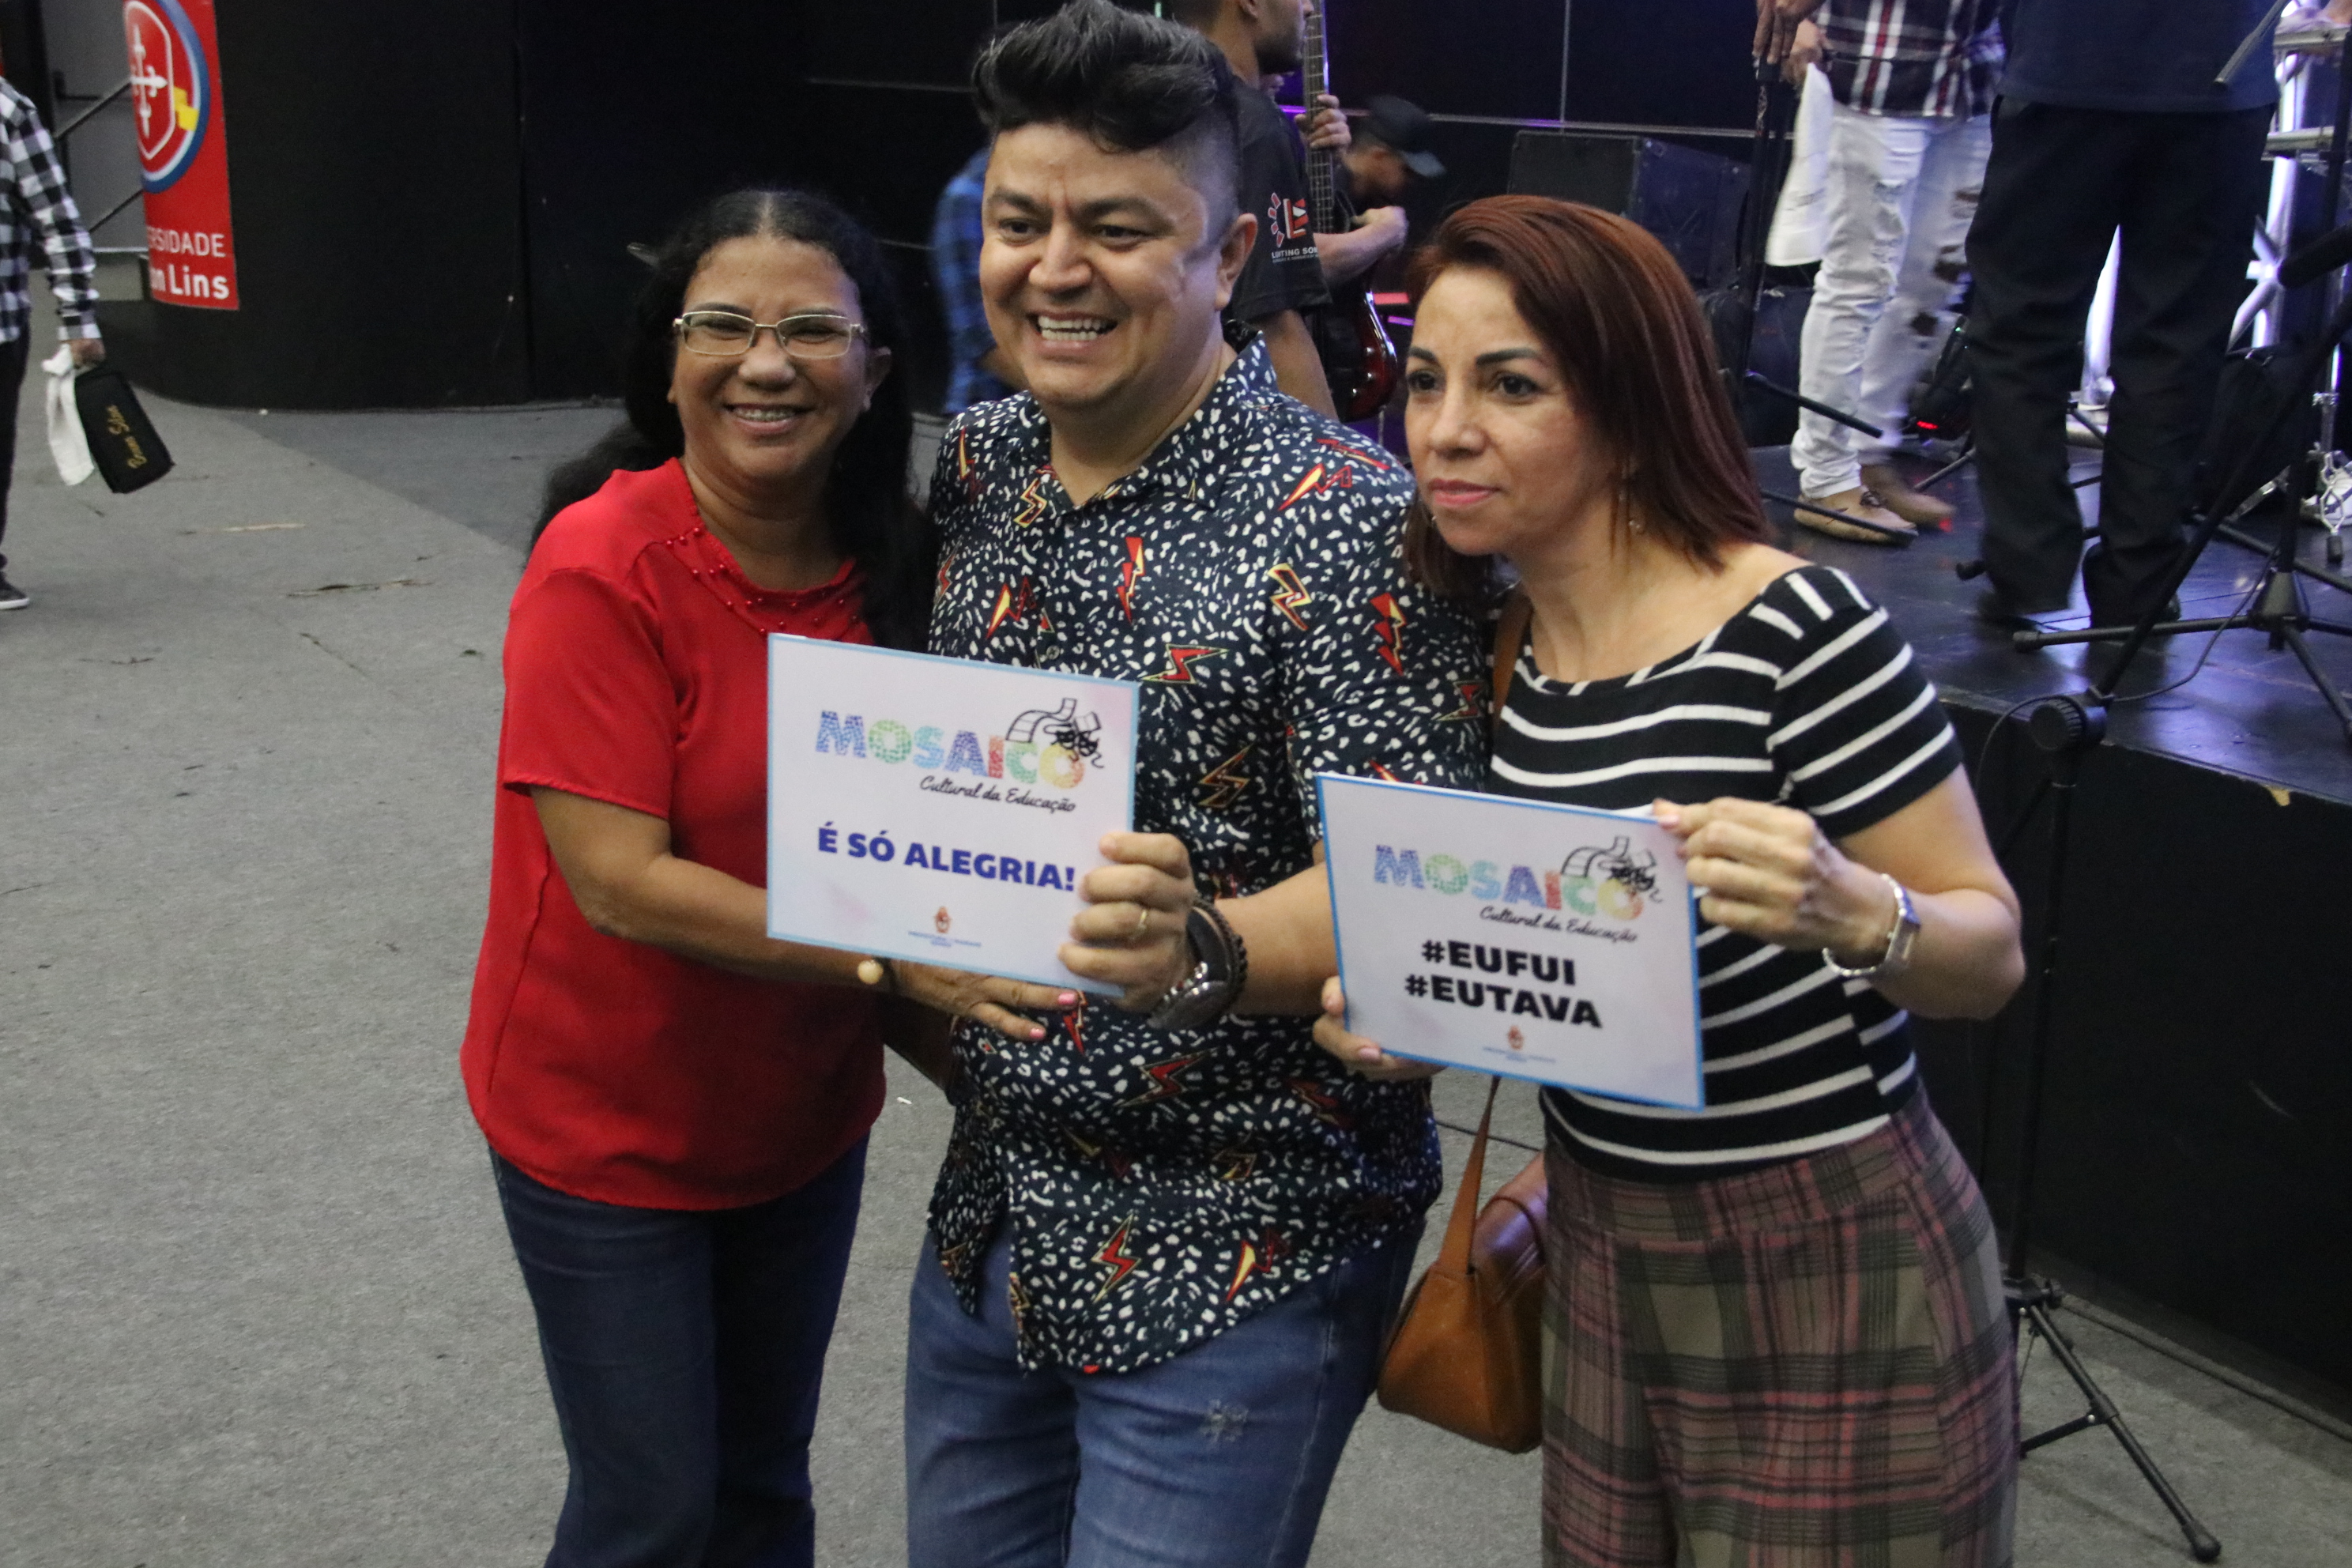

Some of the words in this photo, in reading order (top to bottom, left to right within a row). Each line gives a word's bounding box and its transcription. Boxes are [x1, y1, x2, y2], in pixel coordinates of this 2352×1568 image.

[168, 264, 230, 300] Lins
[816, 710, 1085, 789] MOSAICO
[919, 775, 984, 799] Cultural
[982, 784, 1001, 801] da
[1005, 787, 1076, 814] Educação
[817, 821, 839, 854] É
[846, 830, 896, 863] SÓ
[903, 842, 1076, 892] ALEGRIA!
[1374, 846, 1644, 919] MOSAICO
[1479, 905, 1544, 928] Cultural
[1543, 914, 1562, 932] da
[1566, 917, 1638, 944] Educação
[1422, 940, 1576, 986] #EUFUI
[1404, 974, 1602, 1028] #EUTAVA
